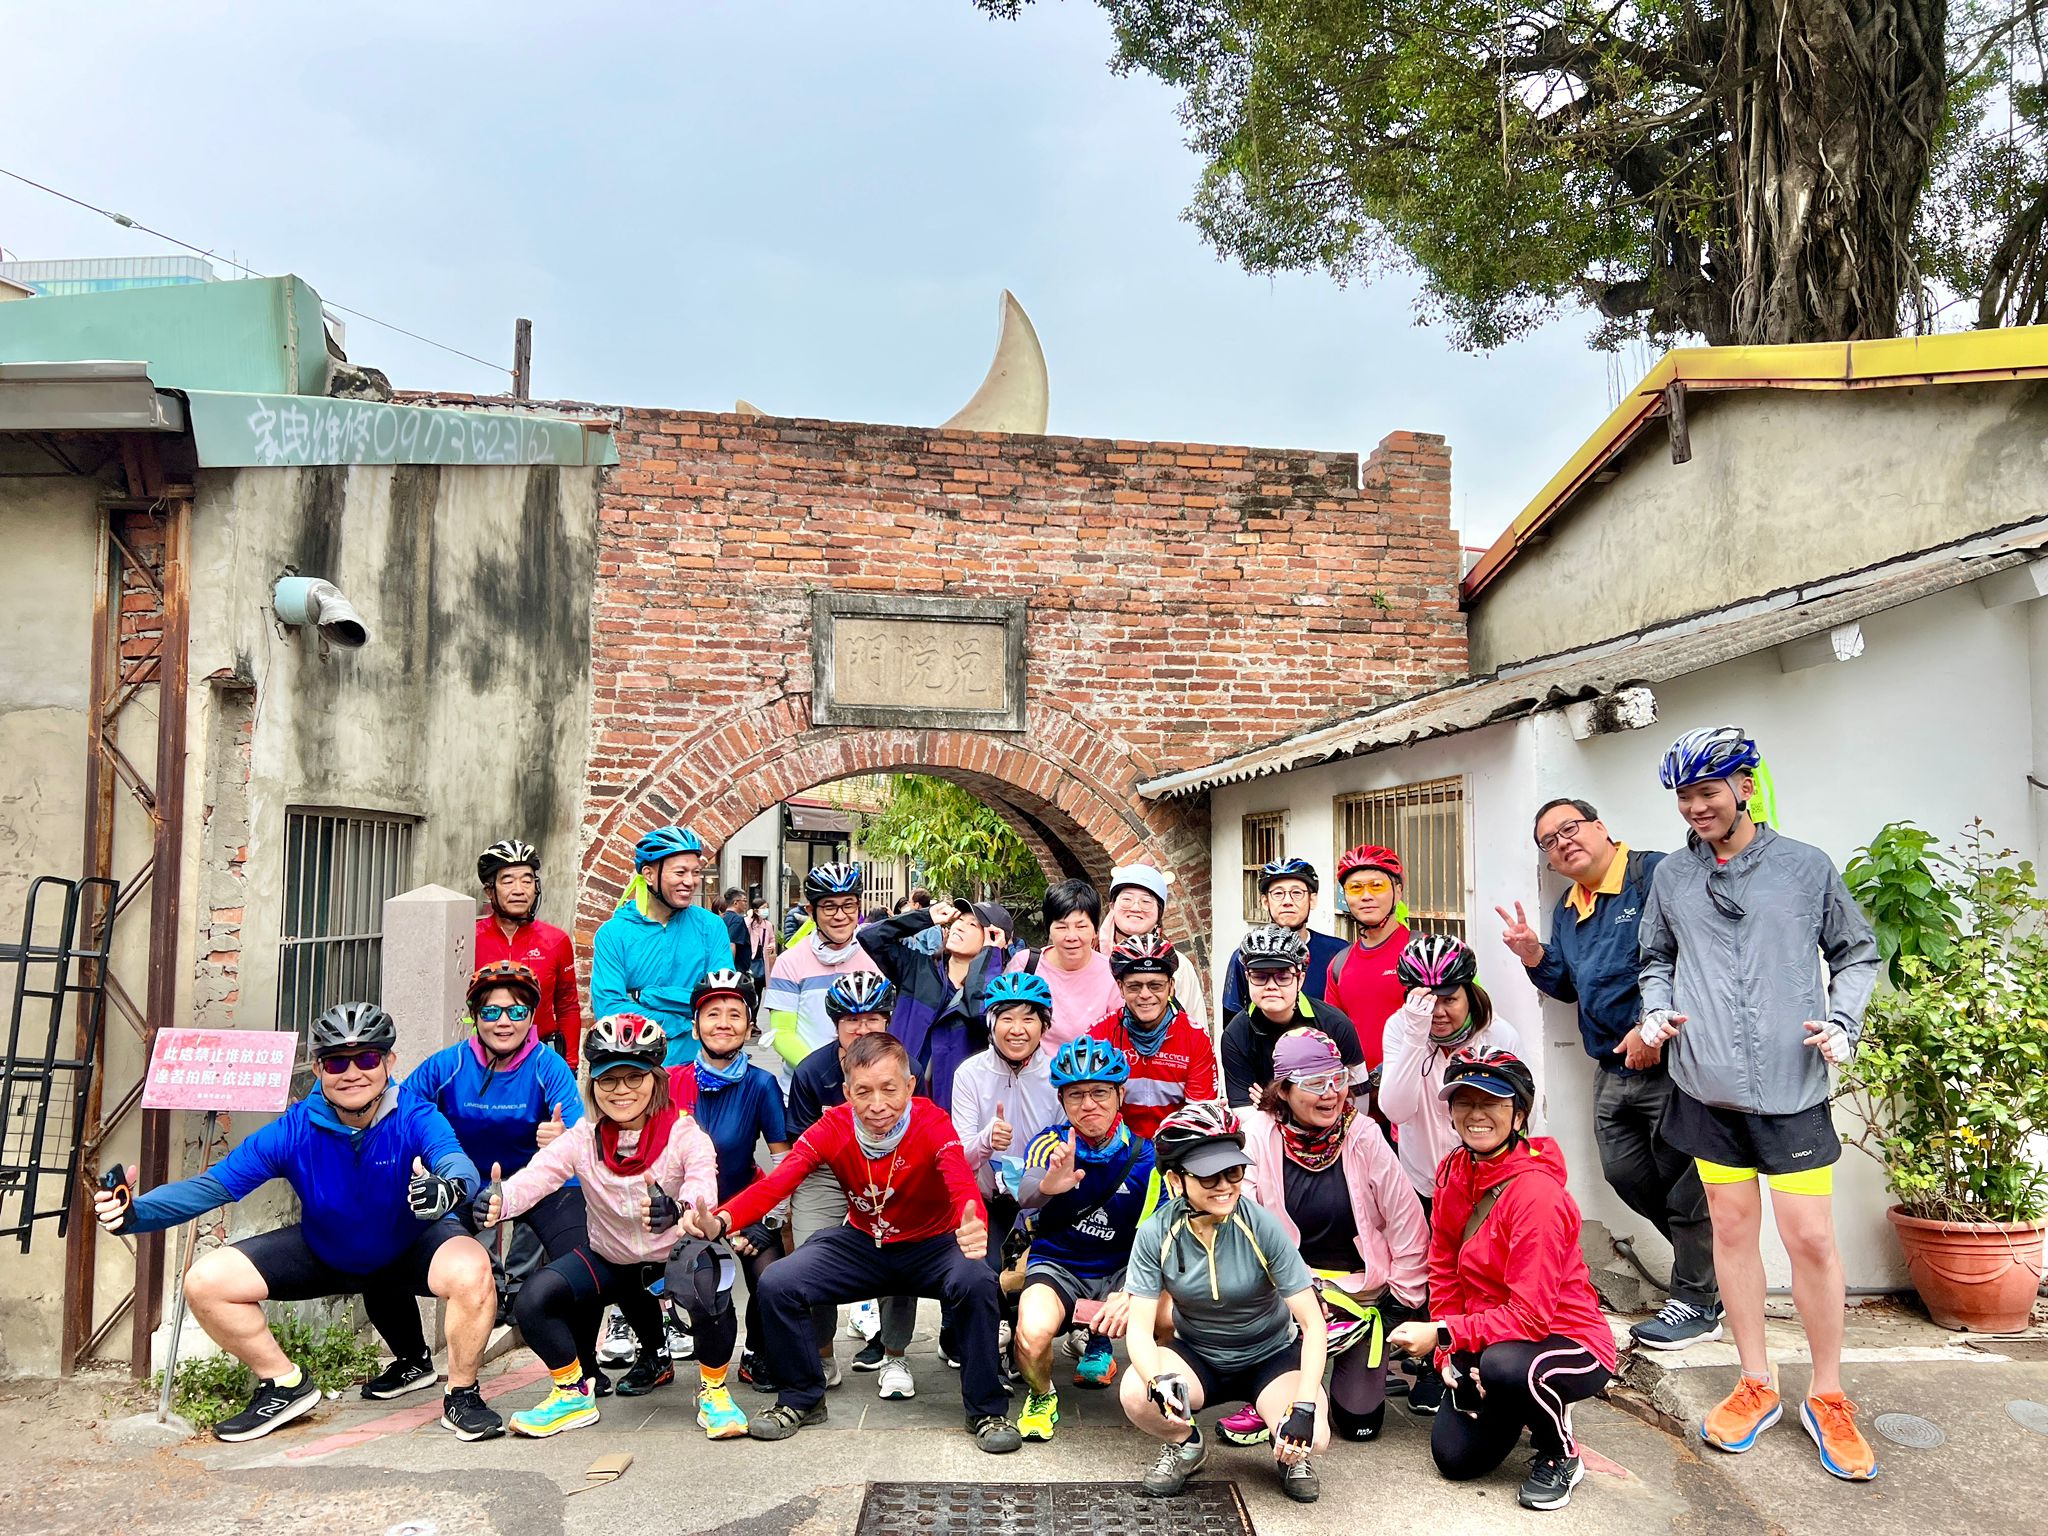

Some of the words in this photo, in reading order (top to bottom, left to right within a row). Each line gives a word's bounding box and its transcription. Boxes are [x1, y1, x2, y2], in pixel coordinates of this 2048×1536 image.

[1168, 1053, 1190, 1063] CYCLE
[463, 1102, 490, 1110] UNDER
[491, 1102, 528, 1110] ARMOUR
[1072, 1218, 1116, 1241] hang
